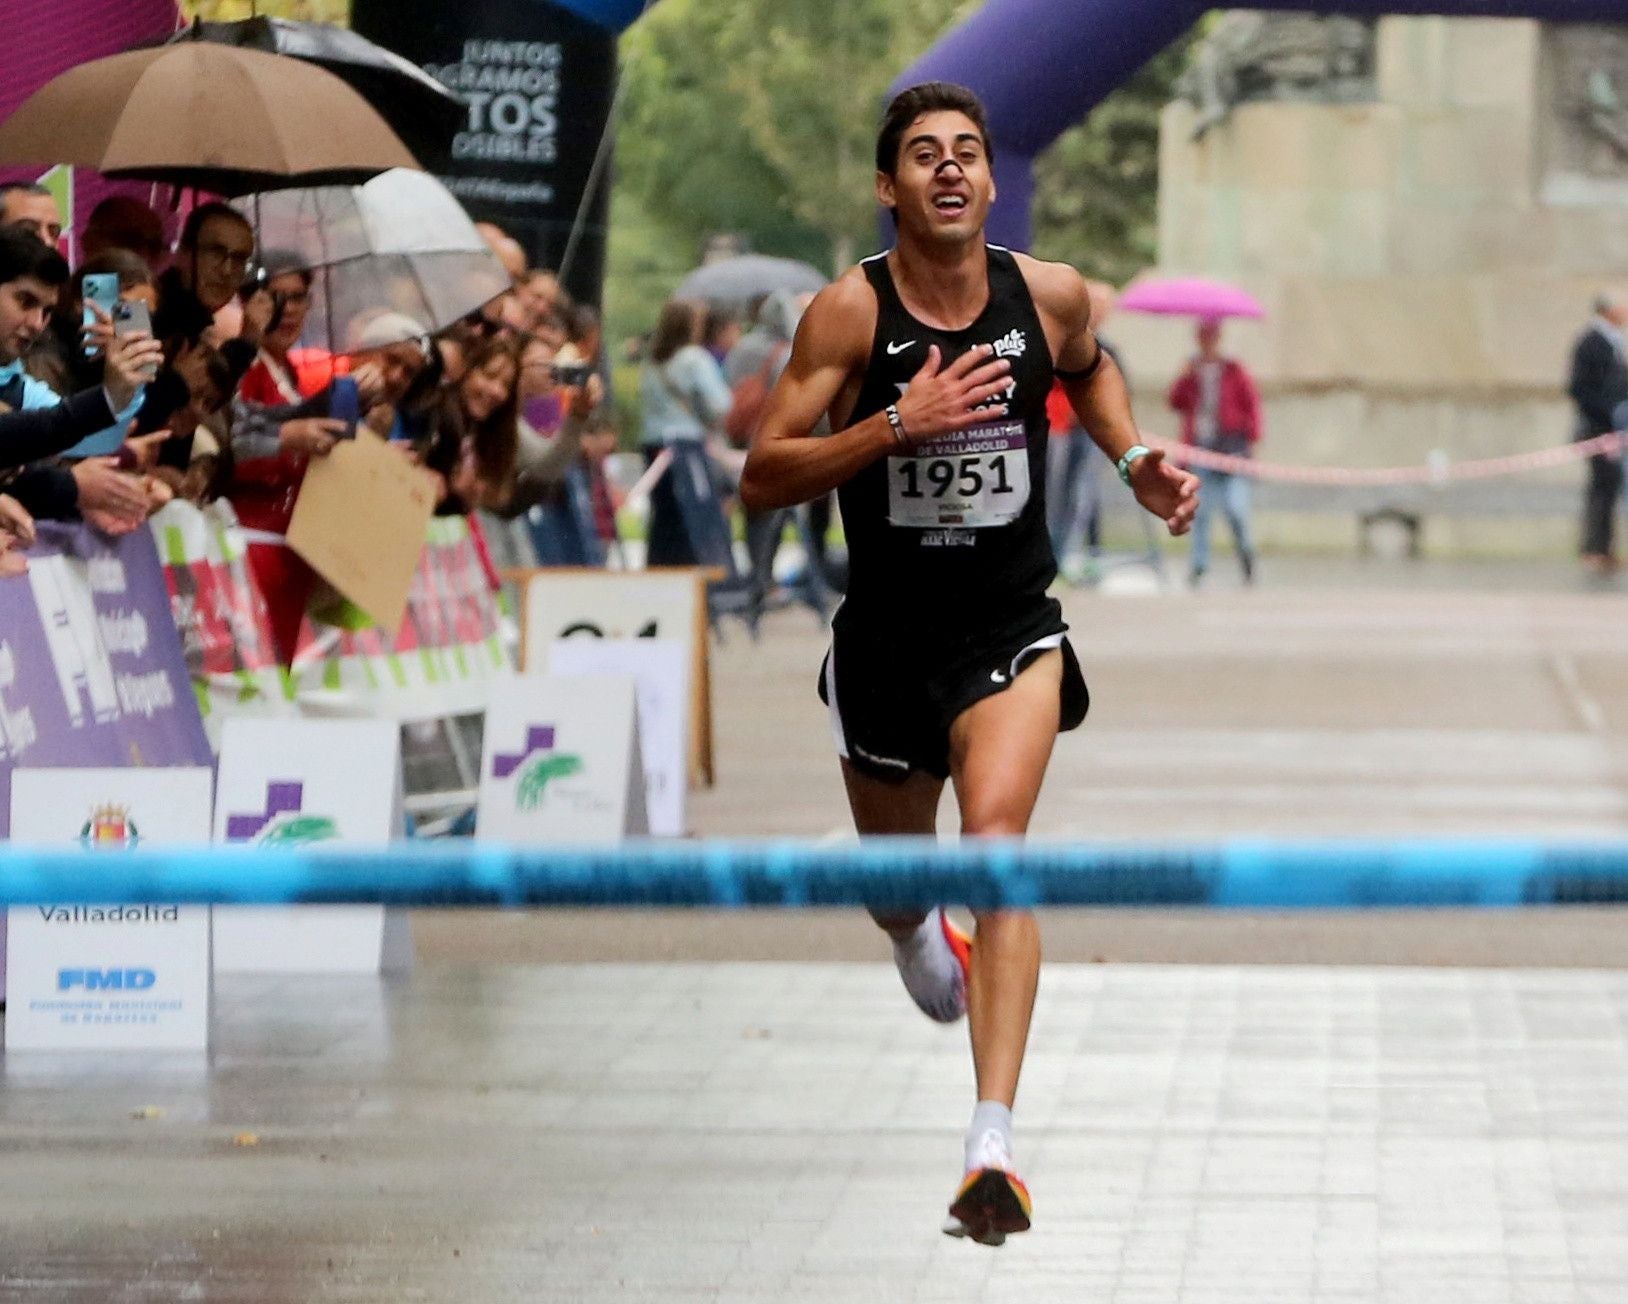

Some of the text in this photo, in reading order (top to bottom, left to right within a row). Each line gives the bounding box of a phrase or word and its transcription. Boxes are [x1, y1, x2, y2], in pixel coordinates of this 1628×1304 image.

[935, 439, 1009, 455] VALLADOLID
[898, 455, 1013, 498] 1951
[39, 905, 178, 922] Valladolid
[58, 969, 156, 990] FMD
